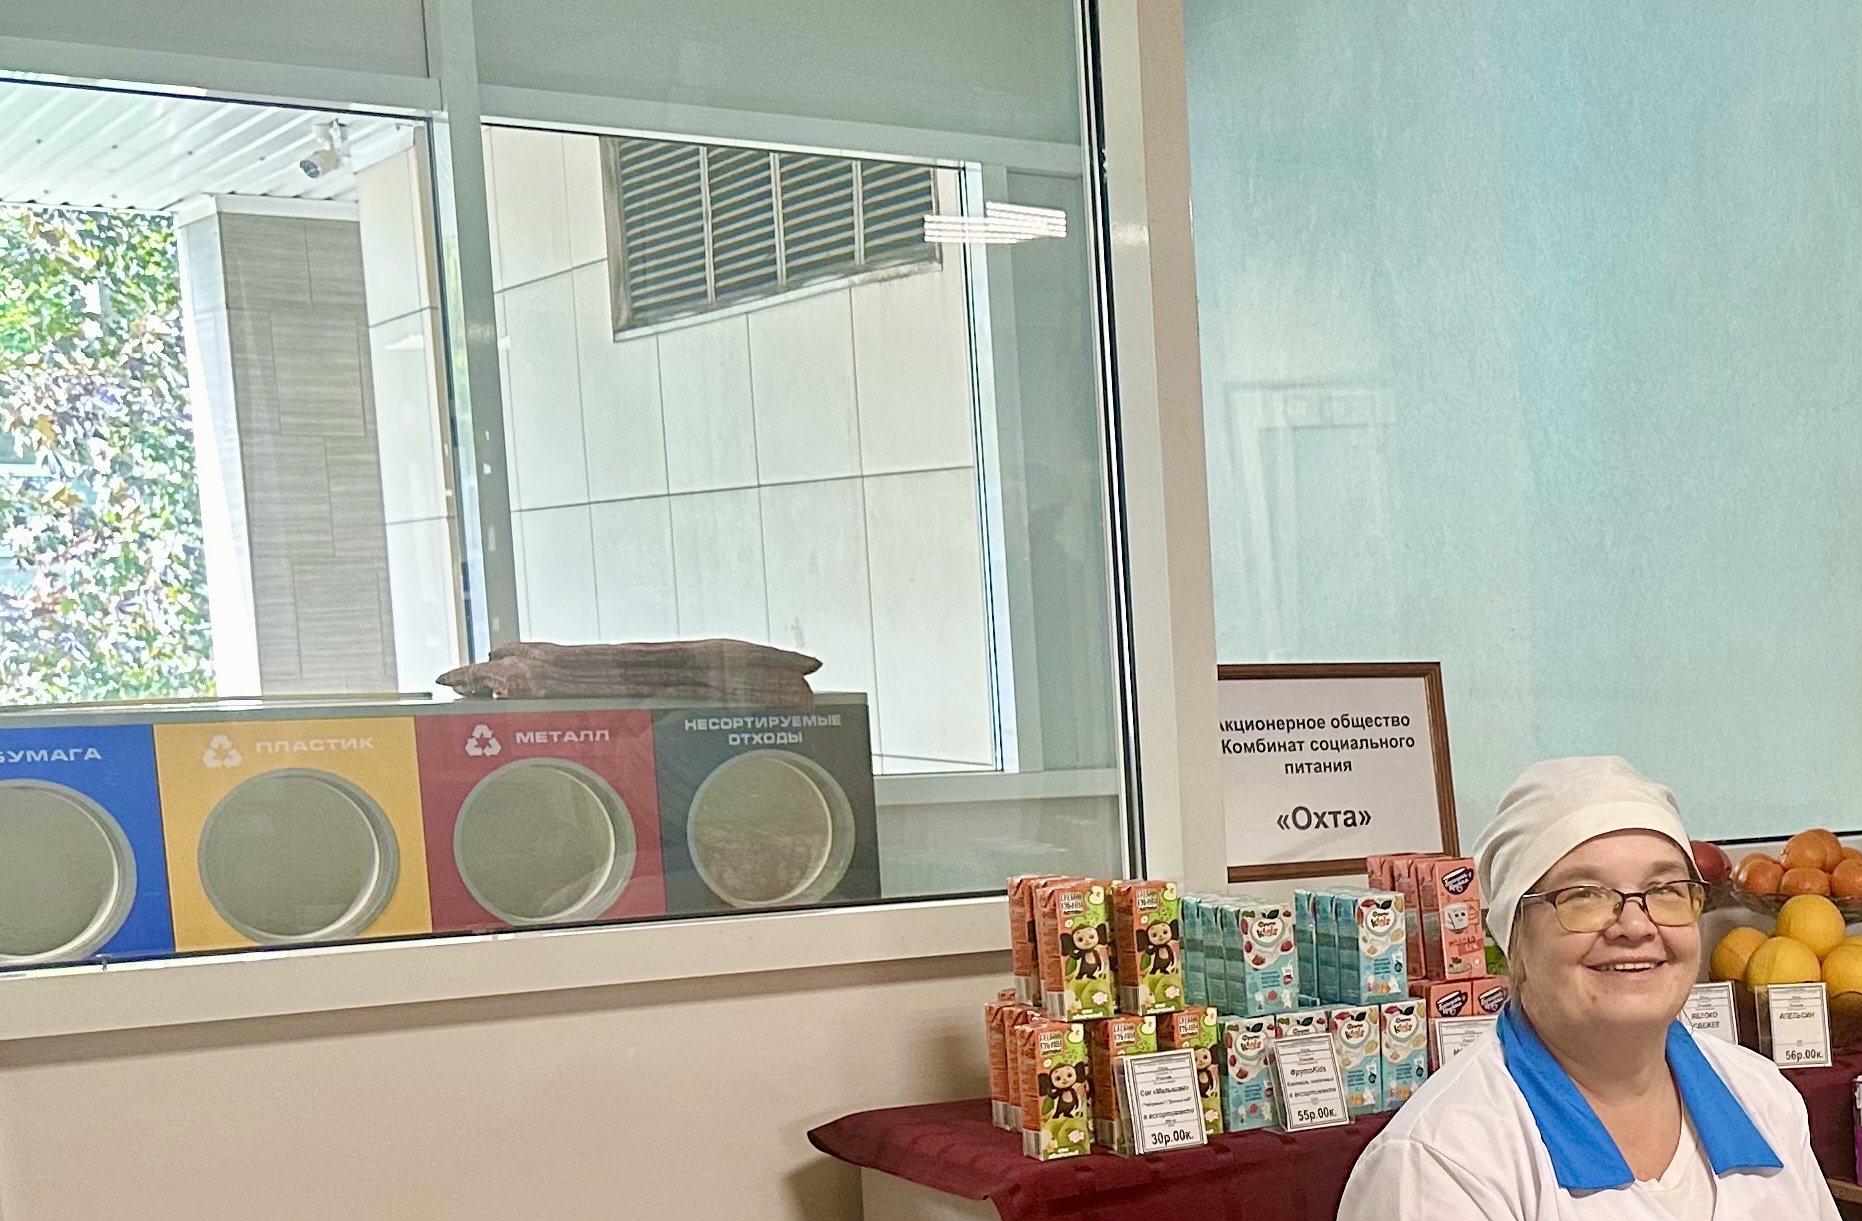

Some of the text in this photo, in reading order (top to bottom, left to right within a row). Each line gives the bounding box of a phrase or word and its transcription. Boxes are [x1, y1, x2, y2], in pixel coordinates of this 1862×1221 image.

[685, 714, 842, 731] НЕСОРТИРУЕМЫЕ
[1331, 713, 1410, 730] общество
[256, 737, 375, 753] ПЛАСТИК
[515, 729, 610, 744] МЕТАЛЛ
[728, 731, 803, 746] ОТХОДЫ
[1221, 736, 1415, 754] Комбинат социального
[1285, 760, 1352, 774] питания
[1276, 806, 1372, 830] «Охта»
[1785, 1048, 1823, 1061] 56р.00к.
[1297, 1106, 1337, 1124] 55р.00к.
[1151, 1129, 1194, 1147] 30р.00к.
